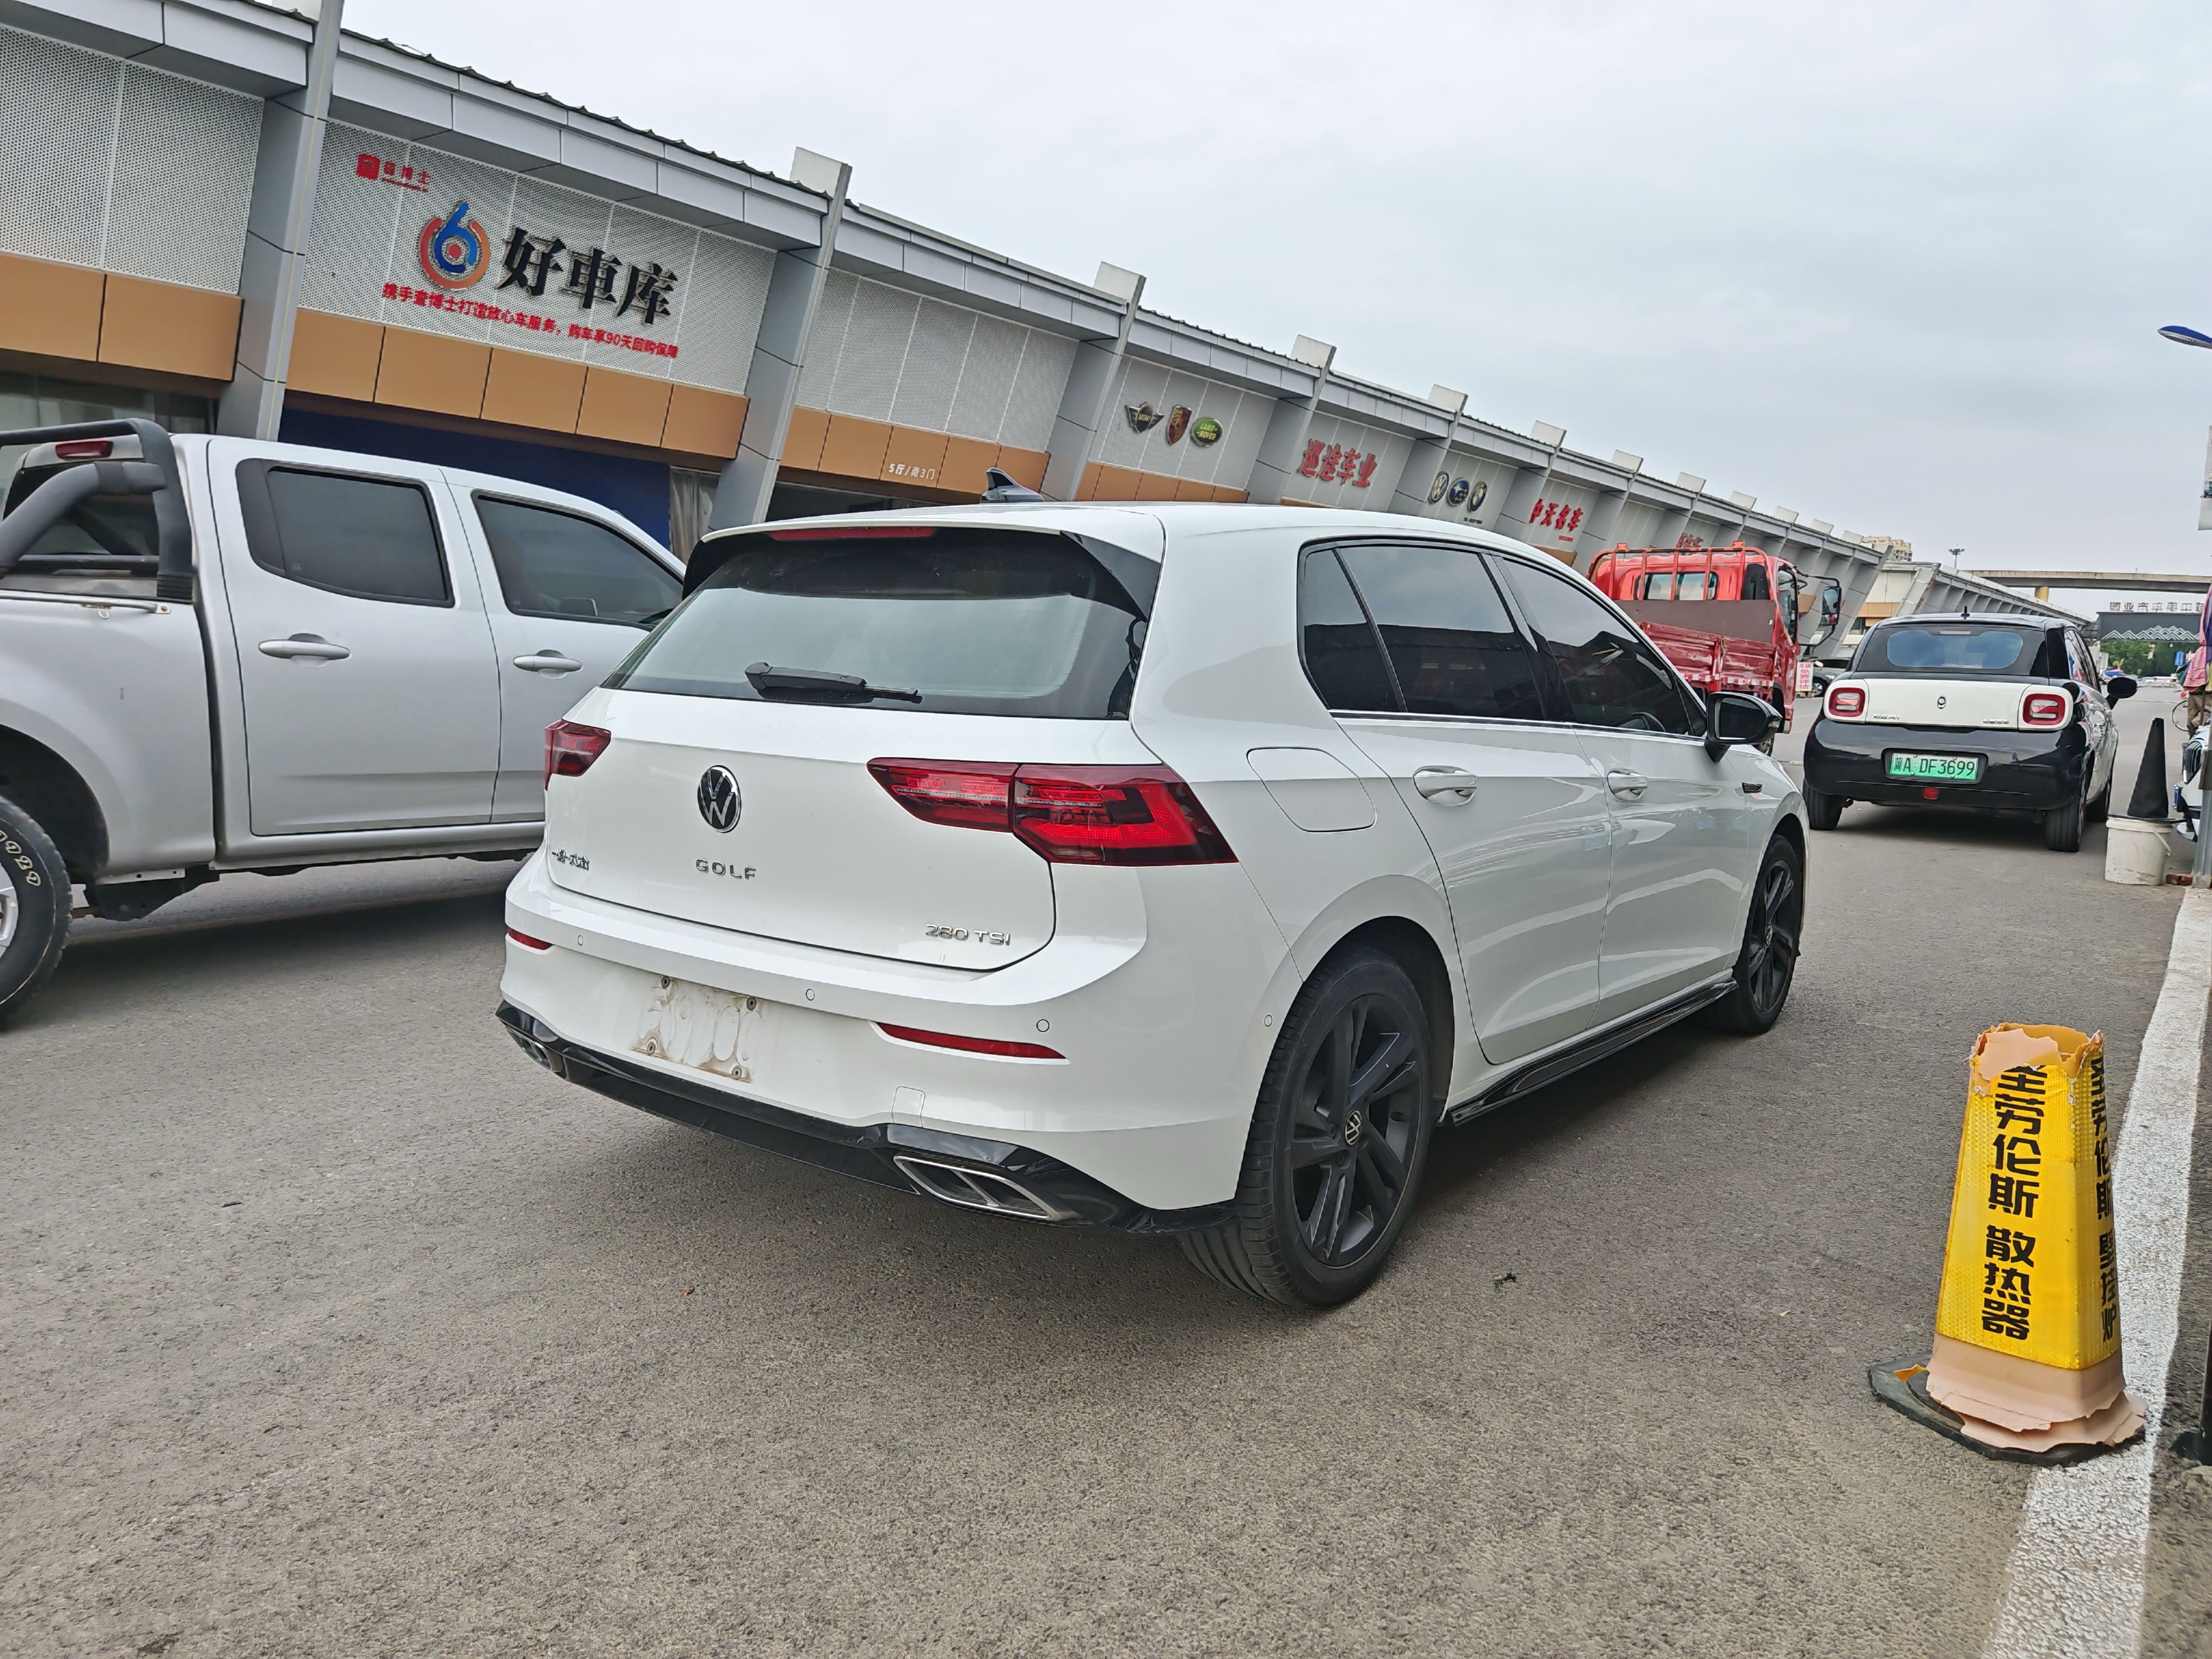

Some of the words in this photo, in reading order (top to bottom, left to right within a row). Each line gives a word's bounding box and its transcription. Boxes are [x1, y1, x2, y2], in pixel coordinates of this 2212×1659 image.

[494, 227, 678, 325] 好車库
[1138, 413, 1151, 422] MINI
[888, 463, 935, 480] 5厅/南3门
[1893, 757, 1911, 772] 冀A
[1919, 758, 1975, 776] DF3699
[696, 859, 756, 880] GOLF
[925, 923, 969, 941] 280
[974, 930, 1011, 946] TSI
[1981, 1224, 2036, 1340] 散热器
